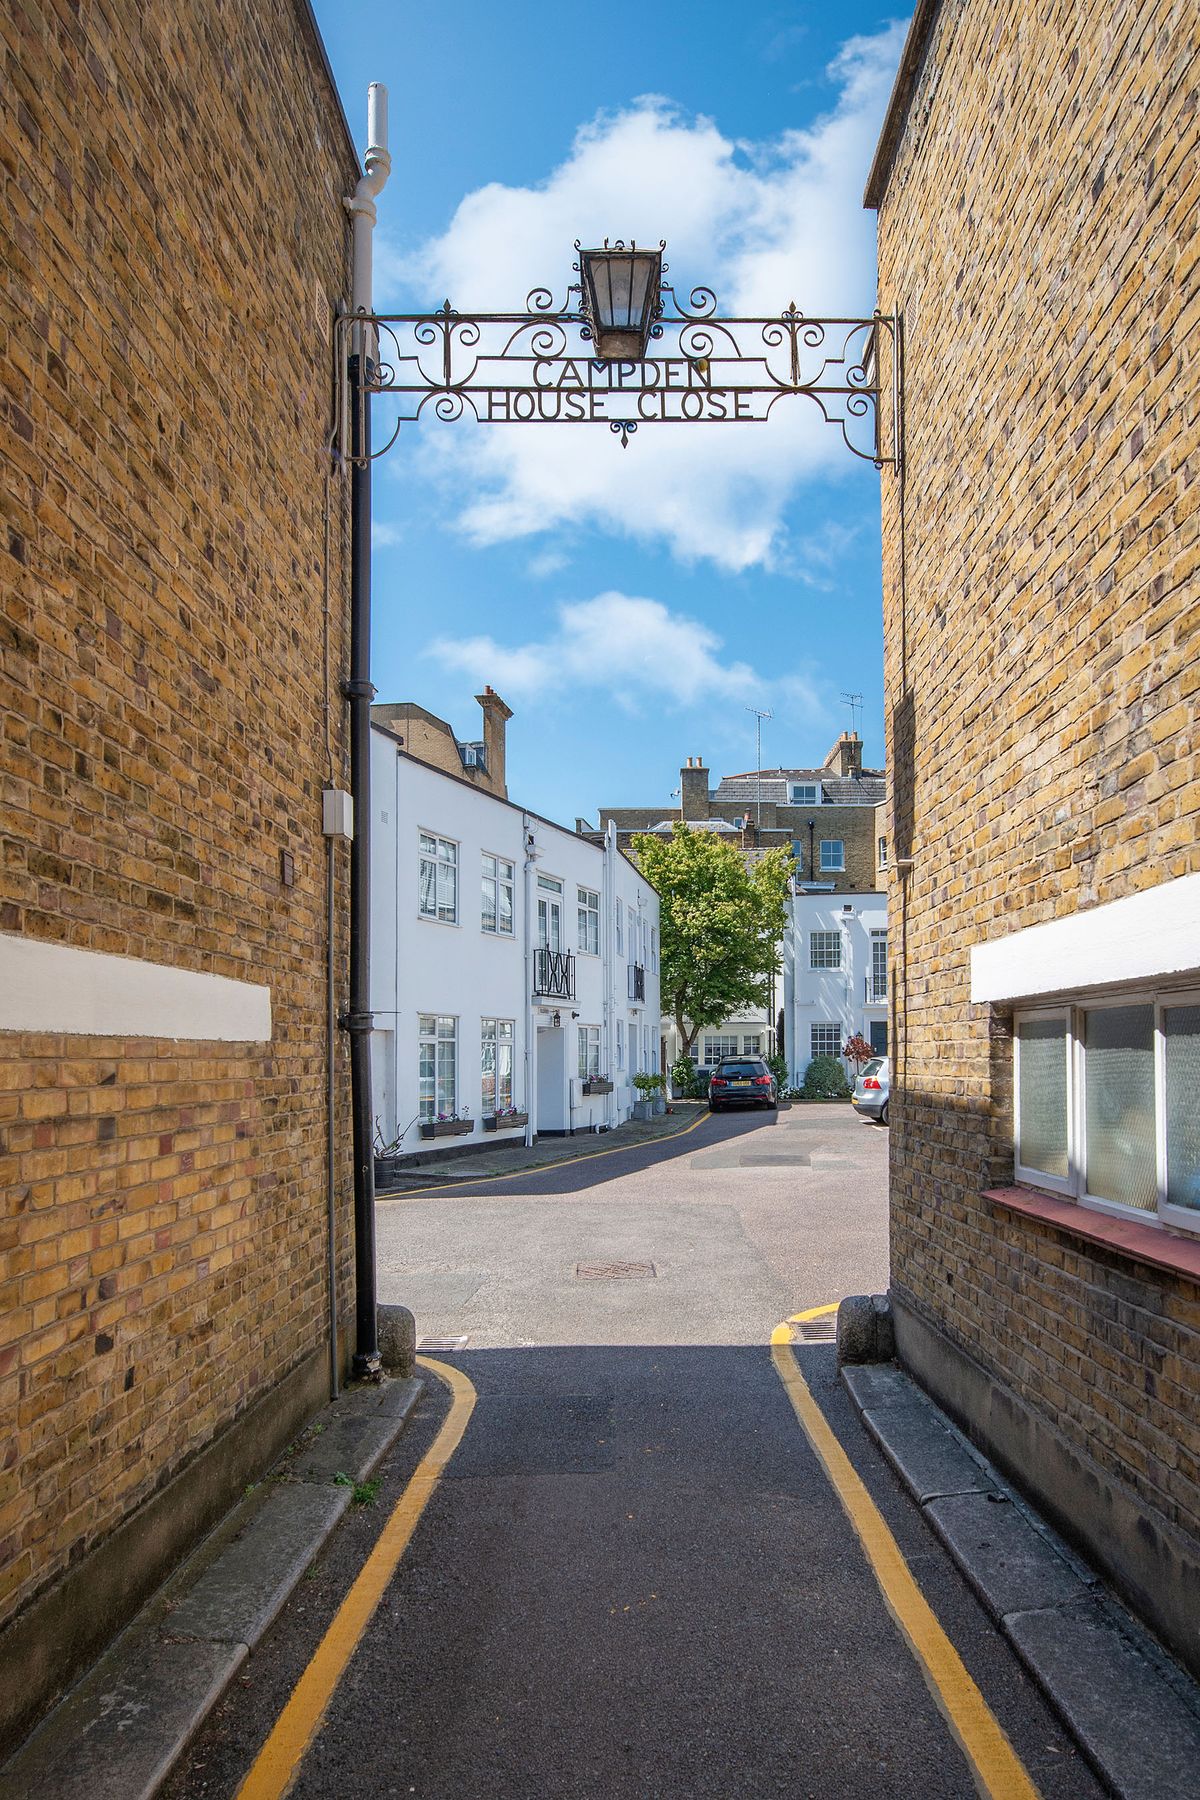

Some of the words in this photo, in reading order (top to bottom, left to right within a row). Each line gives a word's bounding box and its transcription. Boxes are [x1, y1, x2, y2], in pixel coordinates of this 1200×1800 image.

[532, 360, 712, 388] CAMPDEN
[487, 391, 609, 420] HOUSE
[637, 391, 754, 420] CLOSE
